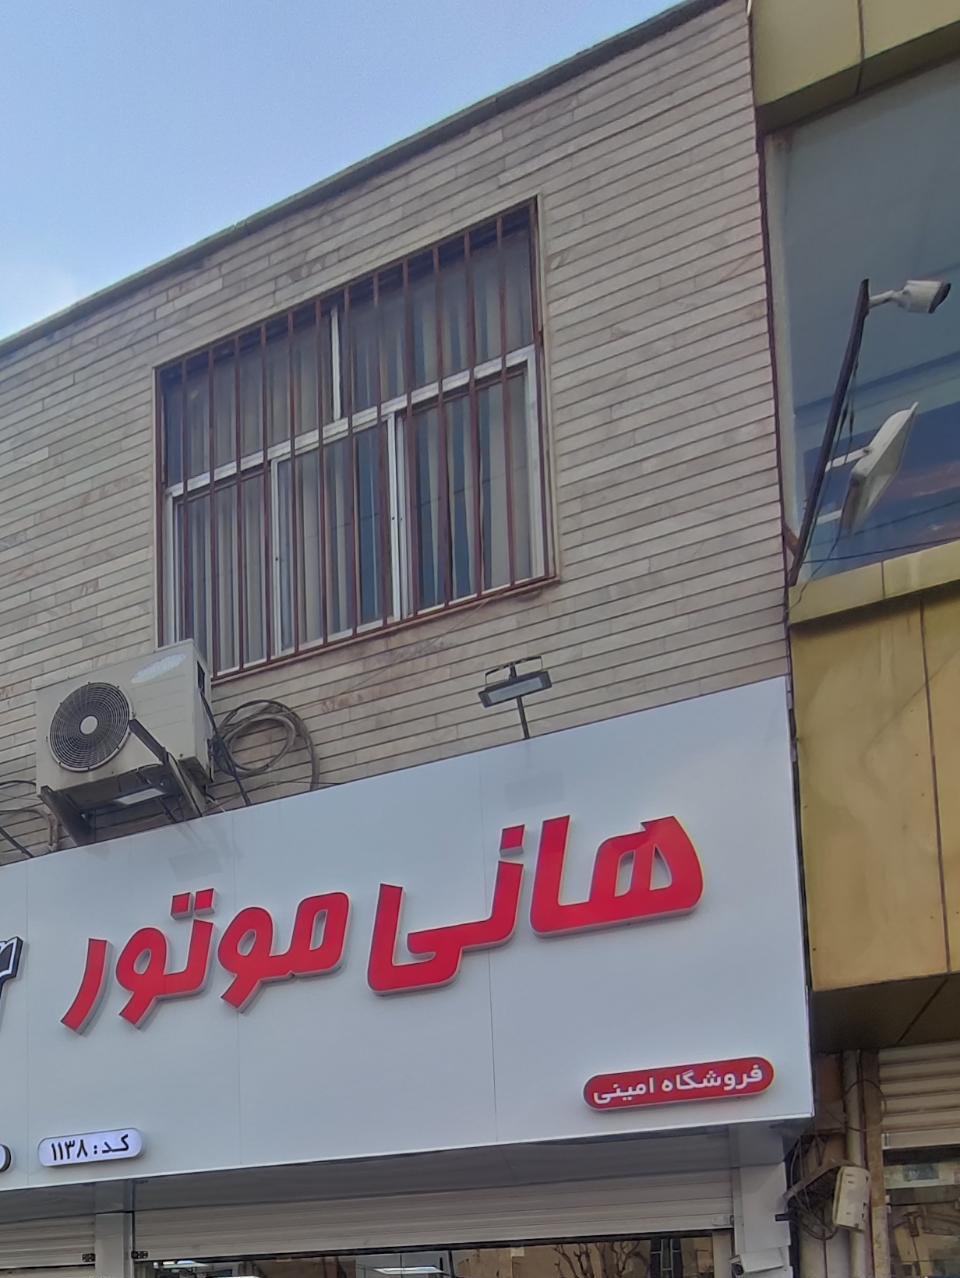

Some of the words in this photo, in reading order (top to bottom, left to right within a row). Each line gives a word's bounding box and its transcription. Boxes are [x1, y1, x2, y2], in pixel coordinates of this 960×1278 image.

[367, 814, 704, 997] هانی
[60, 887, 350, 1034] موتور
[593, 1078, 655, 1104] امینی
[661, 1064, 763, 1091] فروشگاه
